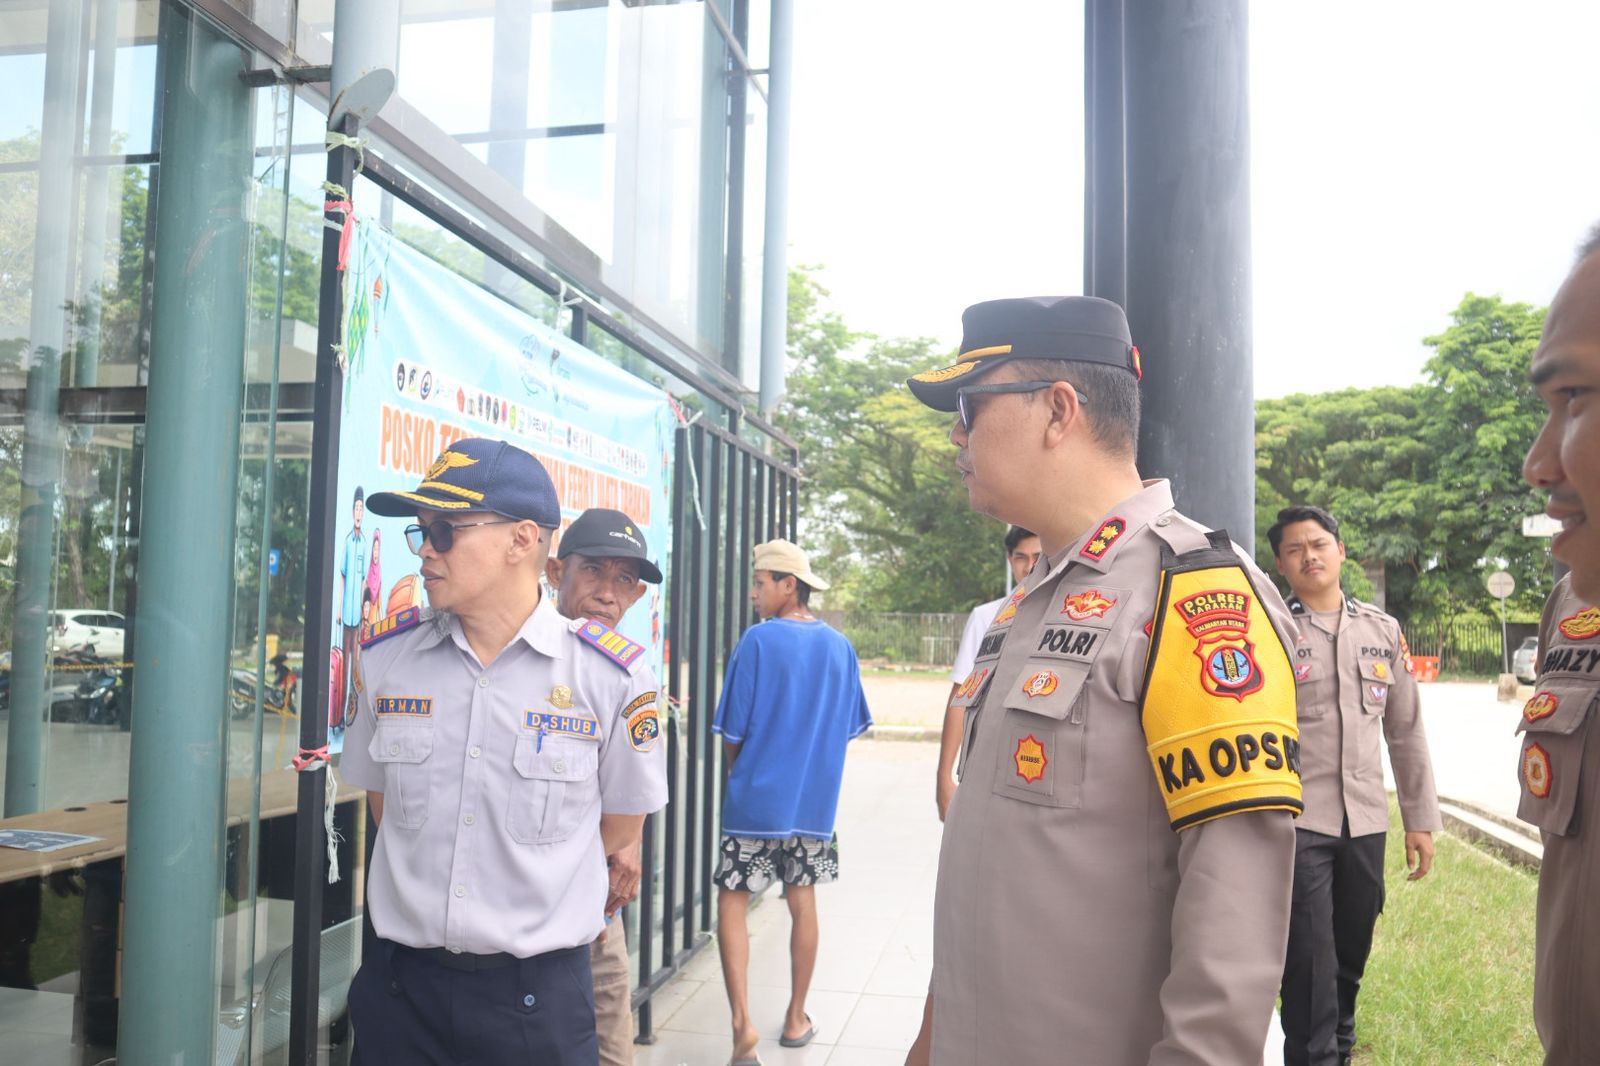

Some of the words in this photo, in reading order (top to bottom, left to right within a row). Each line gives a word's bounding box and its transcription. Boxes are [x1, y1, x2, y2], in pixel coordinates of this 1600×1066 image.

[380, 405, 435, 475] POSKO
[1184, 593, 1245, 614] POLRES
[1191, 602, 1243, 616] TARAKAN
[1038, 629, 1098, 656] POLRI
[1361, 646, 1393, 660] POLRI
[377, 698, 430, 714] FIRMAN
[531, 713, 592, 734] DSHUB
[1158, 747, 1206, 794] KA
